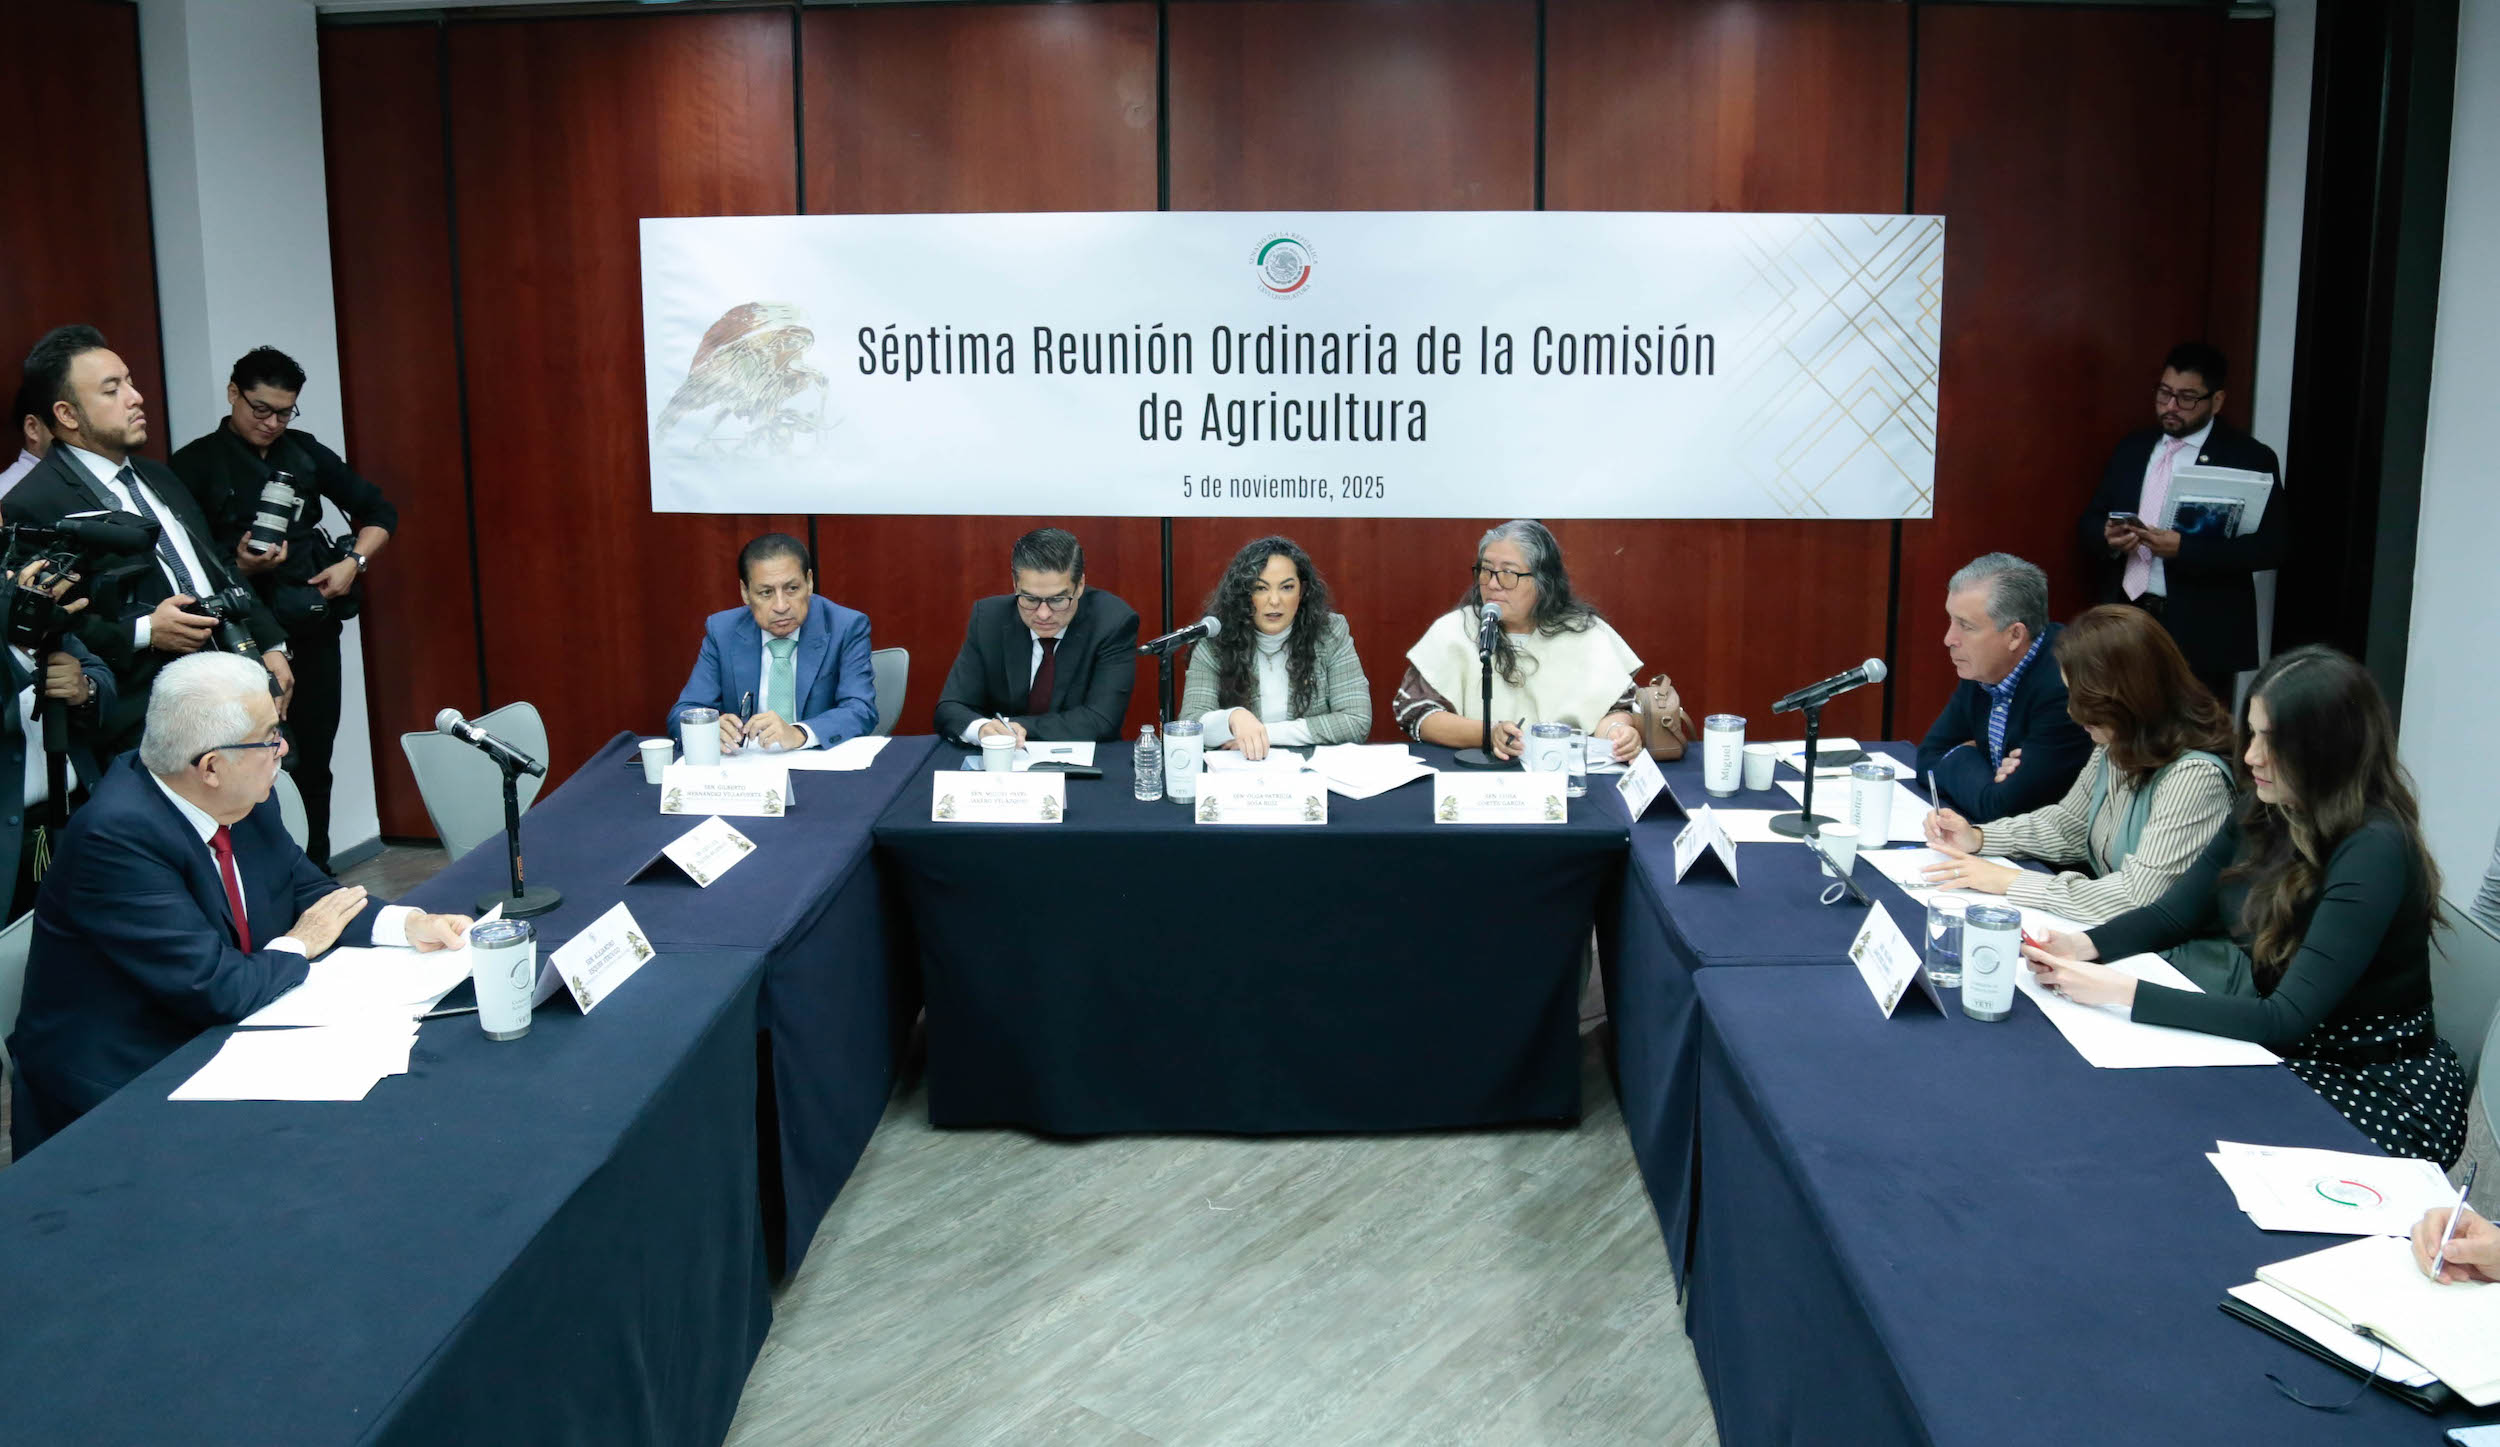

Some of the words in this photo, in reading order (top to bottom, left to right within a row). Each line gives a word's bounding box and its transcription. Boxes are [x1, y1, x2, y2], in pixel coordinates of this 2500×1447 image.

[1249, 239, 1267, 265] SENADO
[1268, 232, 1277, 240] DE
[858, 323, 1015, 382] Séptima
[1033, 324, 1193, 375] Reunión
[1212, 323, 1397, 375] Ordinaria
[1416, 325, 1461, 376] de
[1481, 325, 1513, 375] la
[1533, 323, 1715, 376] Comisión
[1139, 392, 1183, 442] de
[1200, 391, 1427, 448] Agricultura
[1183, 475, 1192, 498] 5
[1201, 475, 1222, 498] de
[1230, 475, 1334, 502] noviembre,
[1342, 475, 1384, 499] 2025
[1720, 744, 1733, 781] Miguel
[1974, 1000, 1993, 1009] YETI
